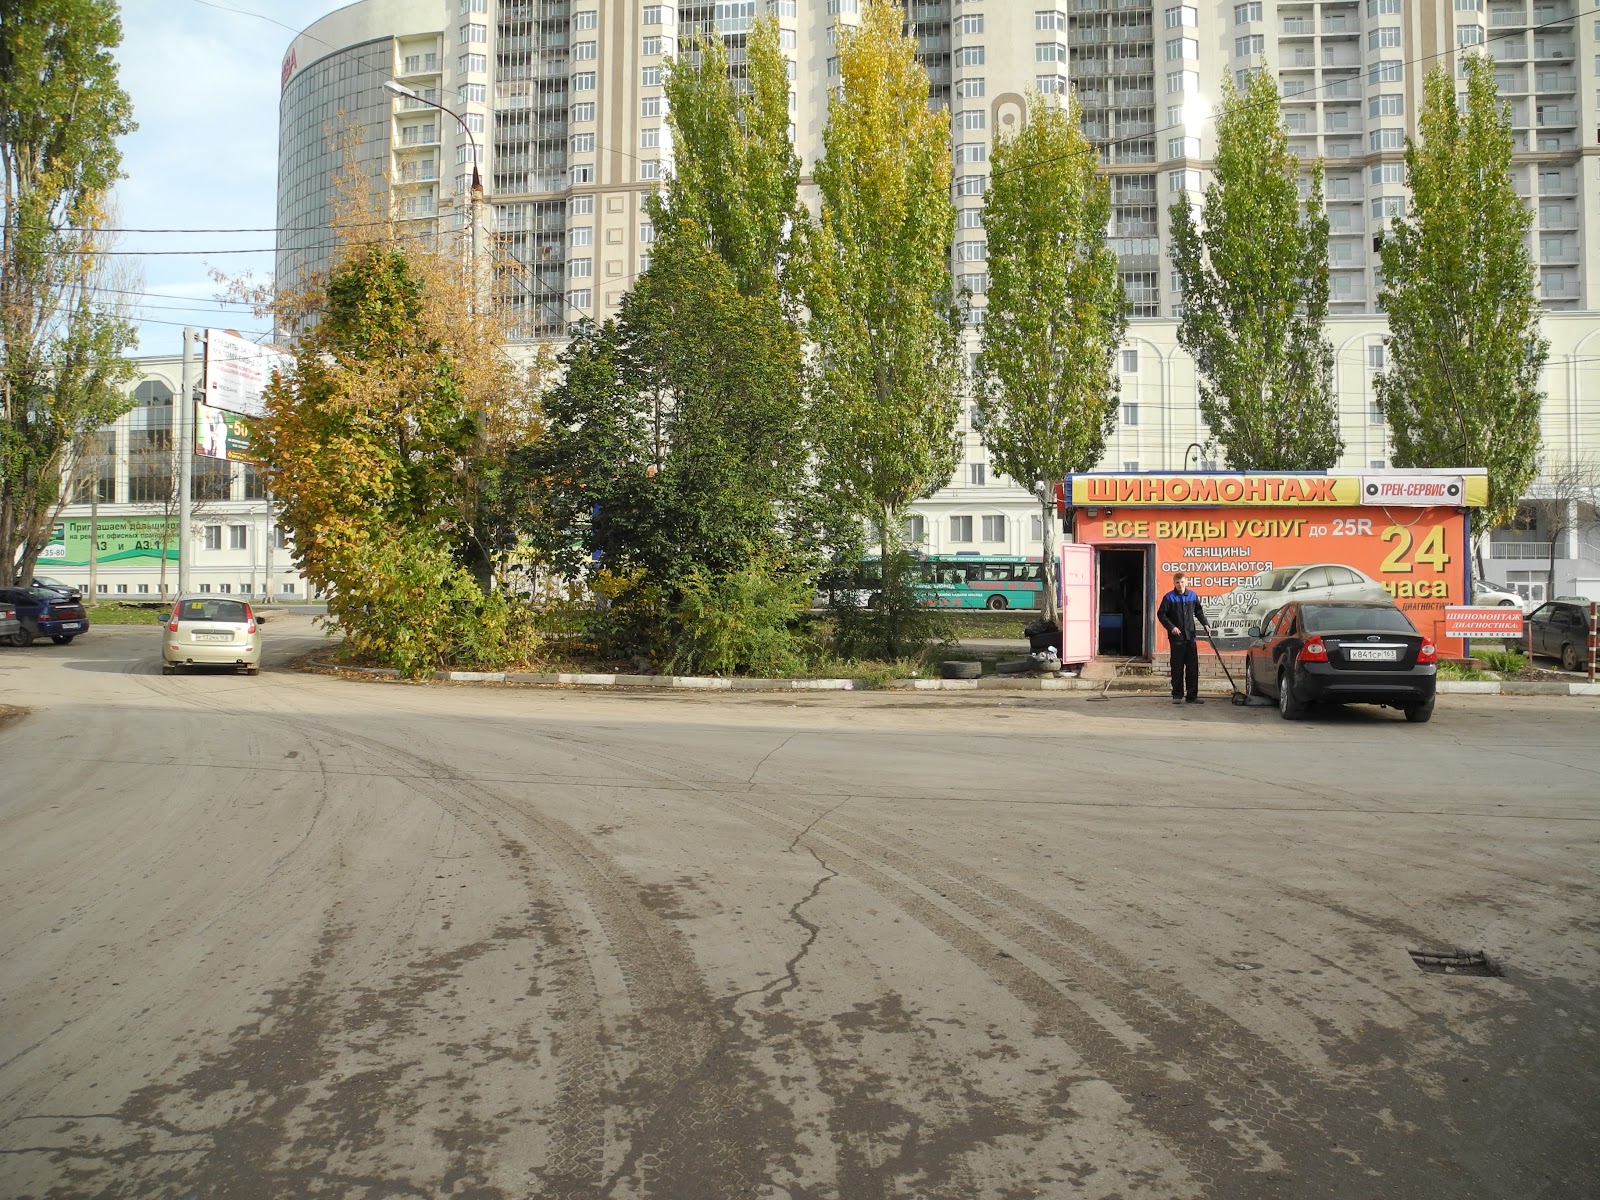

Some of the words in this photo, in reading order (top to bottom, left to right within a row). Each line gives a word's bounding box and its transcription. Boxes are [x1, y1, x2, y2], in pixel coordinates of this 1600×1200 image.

[1087, 478, 1337, 502] ШИНОМОНТАЖ
[1380, 483, 1446, 497] ТРЕК-СЕРВИС
[70, 522, 127, 533] Пригашаем
[1102, 519, 1150, 539] ВСЕ
[1155, 519, 1227, 541] ВИДЫ
[1232, 519, 1308, 539] УСЛУГ
[1331, 518, 1373, 536] 25R
[80, 533, 105, 541] ремнт
[106, 531, 139, 541] офисных
[38, 549, 65, 557] -35-80
[118, 543, 125, 551] и
[1183, 546, 1251, 559] ЖЕНЩИНЫ
[1379, 525, 1451, 574] 24
[1161, 561, 1274, 573] ОБСЛУЖИВАЮТСЯ
[1204, 576, 1262, 589] ОЧЕРЕДИ
[1199, 595, 1225, 608] ДКА
[1227, 592, 1259, 606] 10%
[1402, 602, 1454, 611] ДИАГНОСТИК
[1446, 613, 1522, 621] ШИНОМОНТАЖ
[1352, 650, 1381, 659] К841СР
